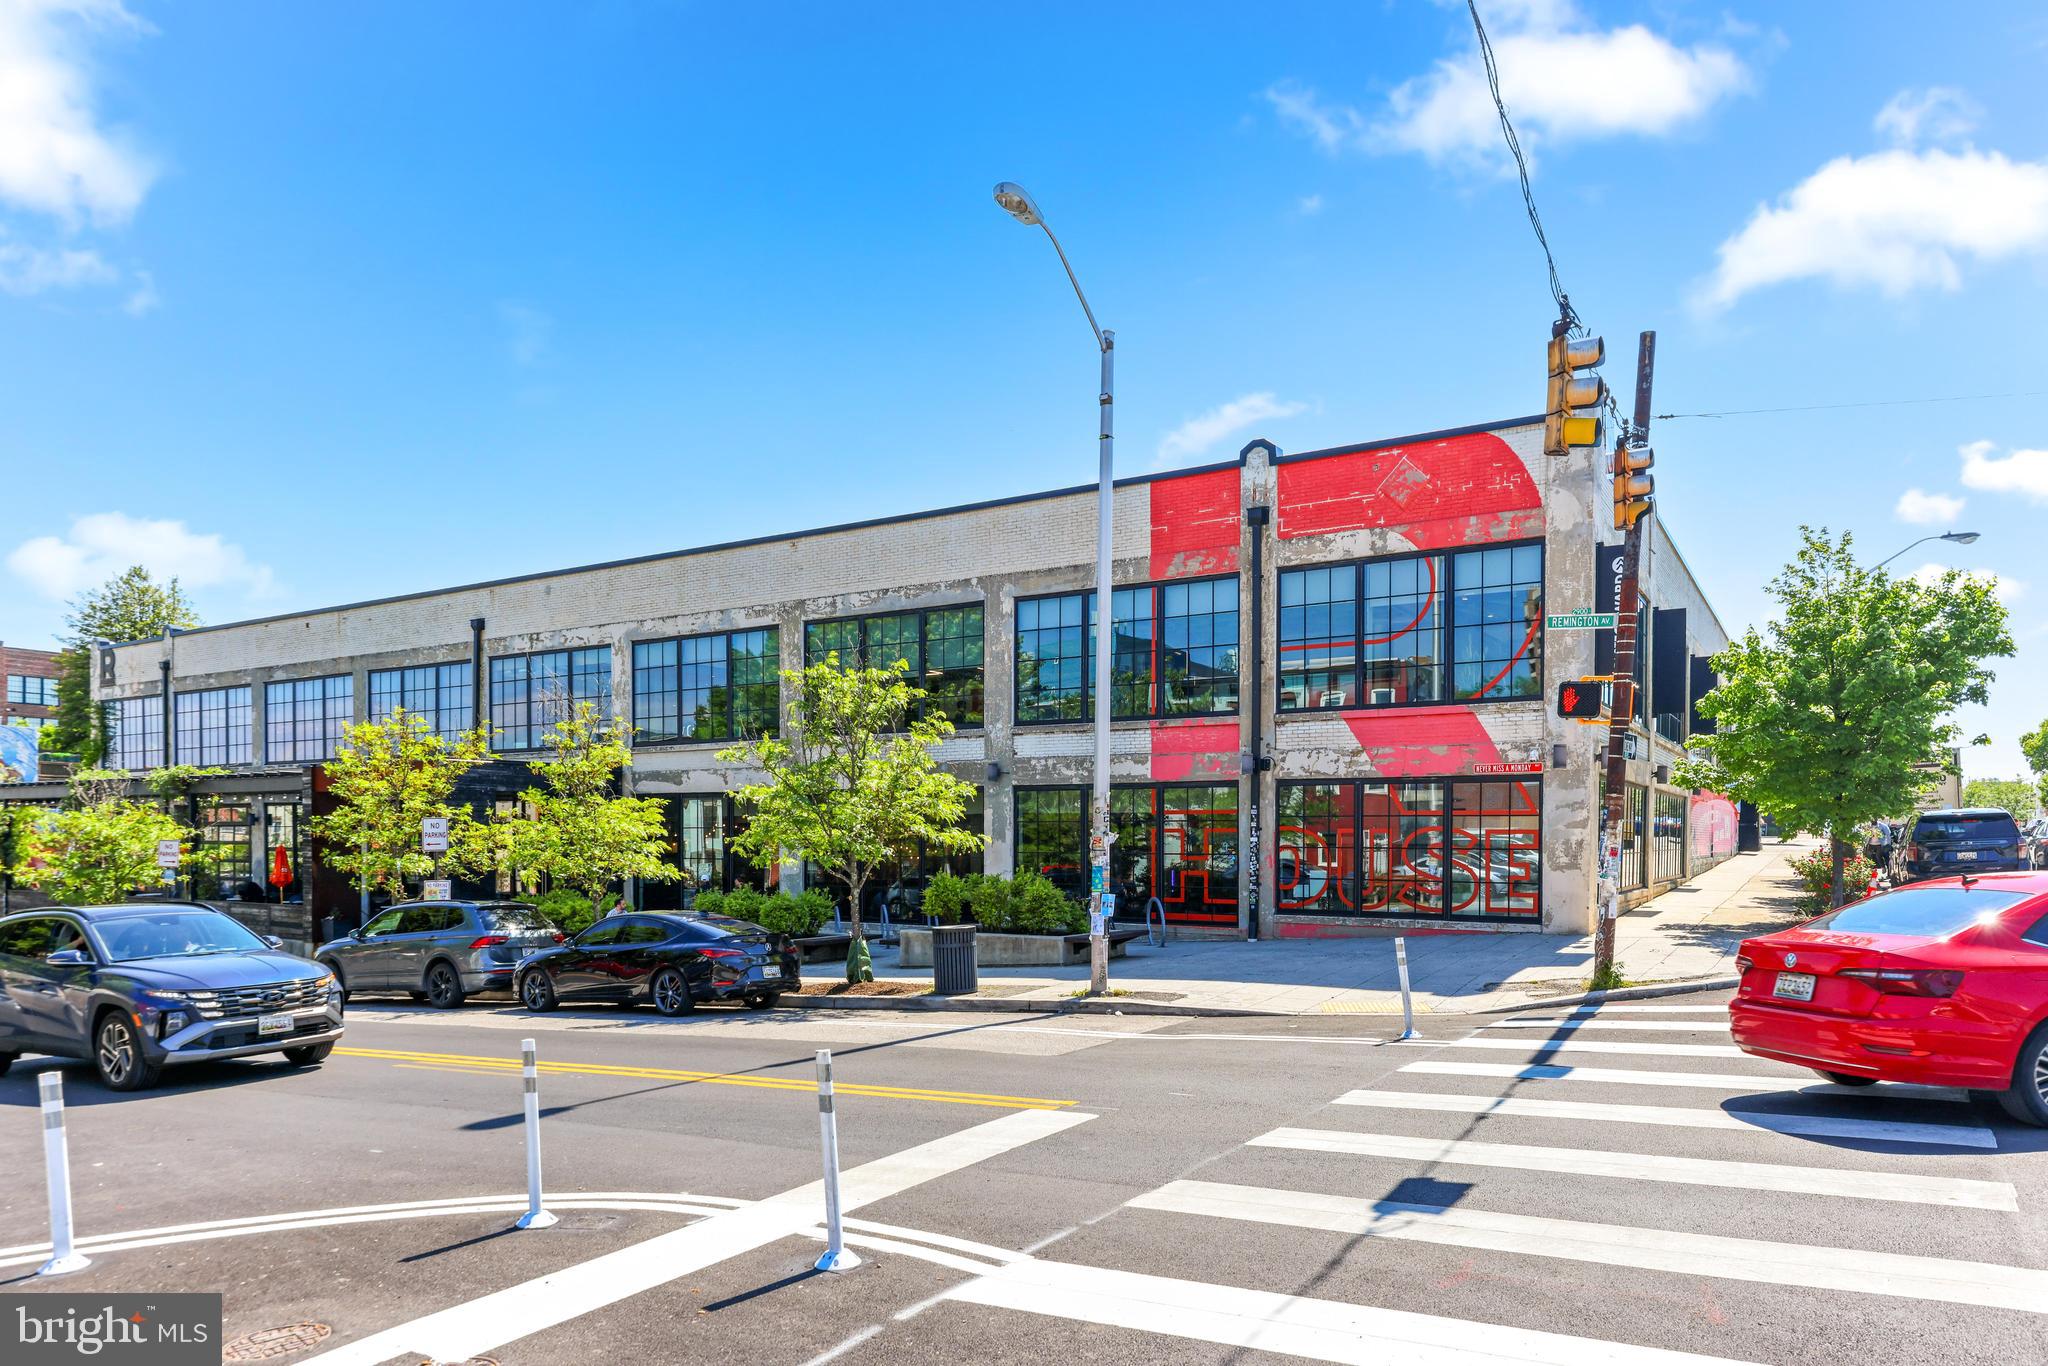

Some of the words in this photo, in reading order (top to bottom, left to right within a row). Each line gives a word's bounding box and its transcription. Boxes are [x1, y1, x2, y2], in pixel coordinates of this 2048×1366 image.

[1552, 616, 1599, 627] REMINGTON
[1492, 764, 1504, 772] MISS
[1505, 764, 1510, 772] A
[1510, 763, 1532, 772] MONDAY
